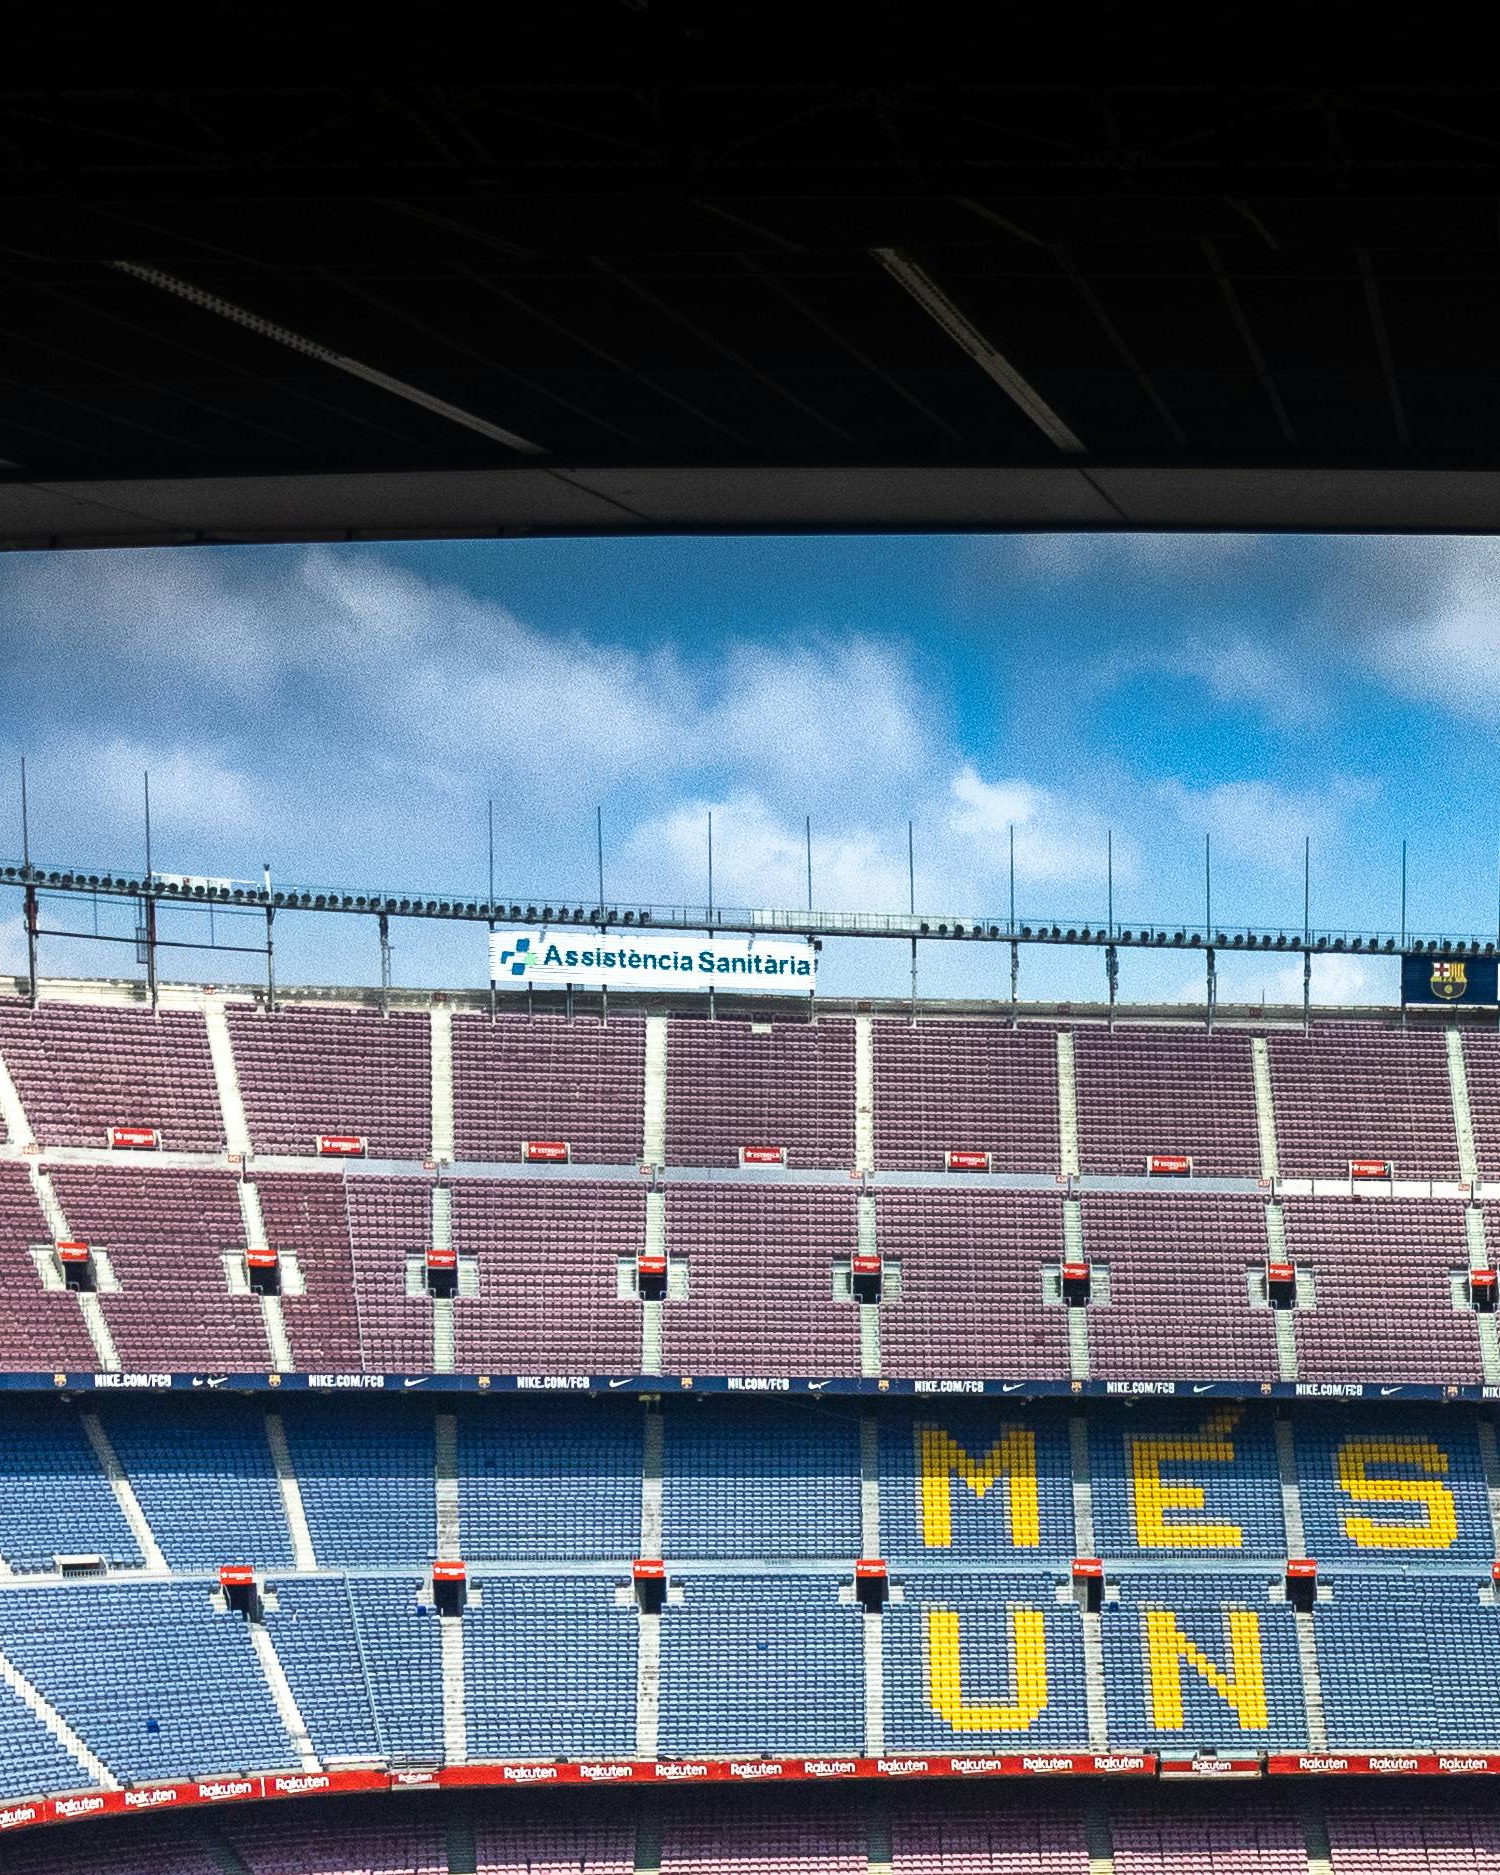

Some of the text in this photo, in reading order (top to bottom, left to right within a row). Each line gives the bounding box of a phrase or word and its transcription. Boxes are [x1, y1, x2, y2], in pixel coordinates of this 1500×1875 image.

[544, 945, 811, 976] Assistència Sanitària
[920, 1404, 1457, 1548] MÉS
[928, 1608, 1269, 1731] UN
[580, 1765, 632, 1780] Rakuten
[656, 1762, 707, 1779] Rakuten
[731, 1761, 782, 1777] Rakuten
[805, 1761, 855, 1777] Rakuten
[878, 1758, 928, 1775] Rakuten
[951, 1759, 1001, 1774] Rakuten
[1023, 1757, 1072, 1773] Rakuten
[1095, 1756, 1143, 1772] Rakuten
[1192, 1761, 1231, 1771] Rakuten
[1300, 1756, 1347, 1773] Rakuten
[1369, 1757, 1417, 1773] Rakuten
[1440, 1758, 1488, 1773] Rakuten
[504, 1765, 557, 1782] Rakuten
[199, 1779, 251, 1800] Rakuten
[276, 1776, 329, 1793] Rakuten
[56, 1798, 103, 1816] Rakuten
